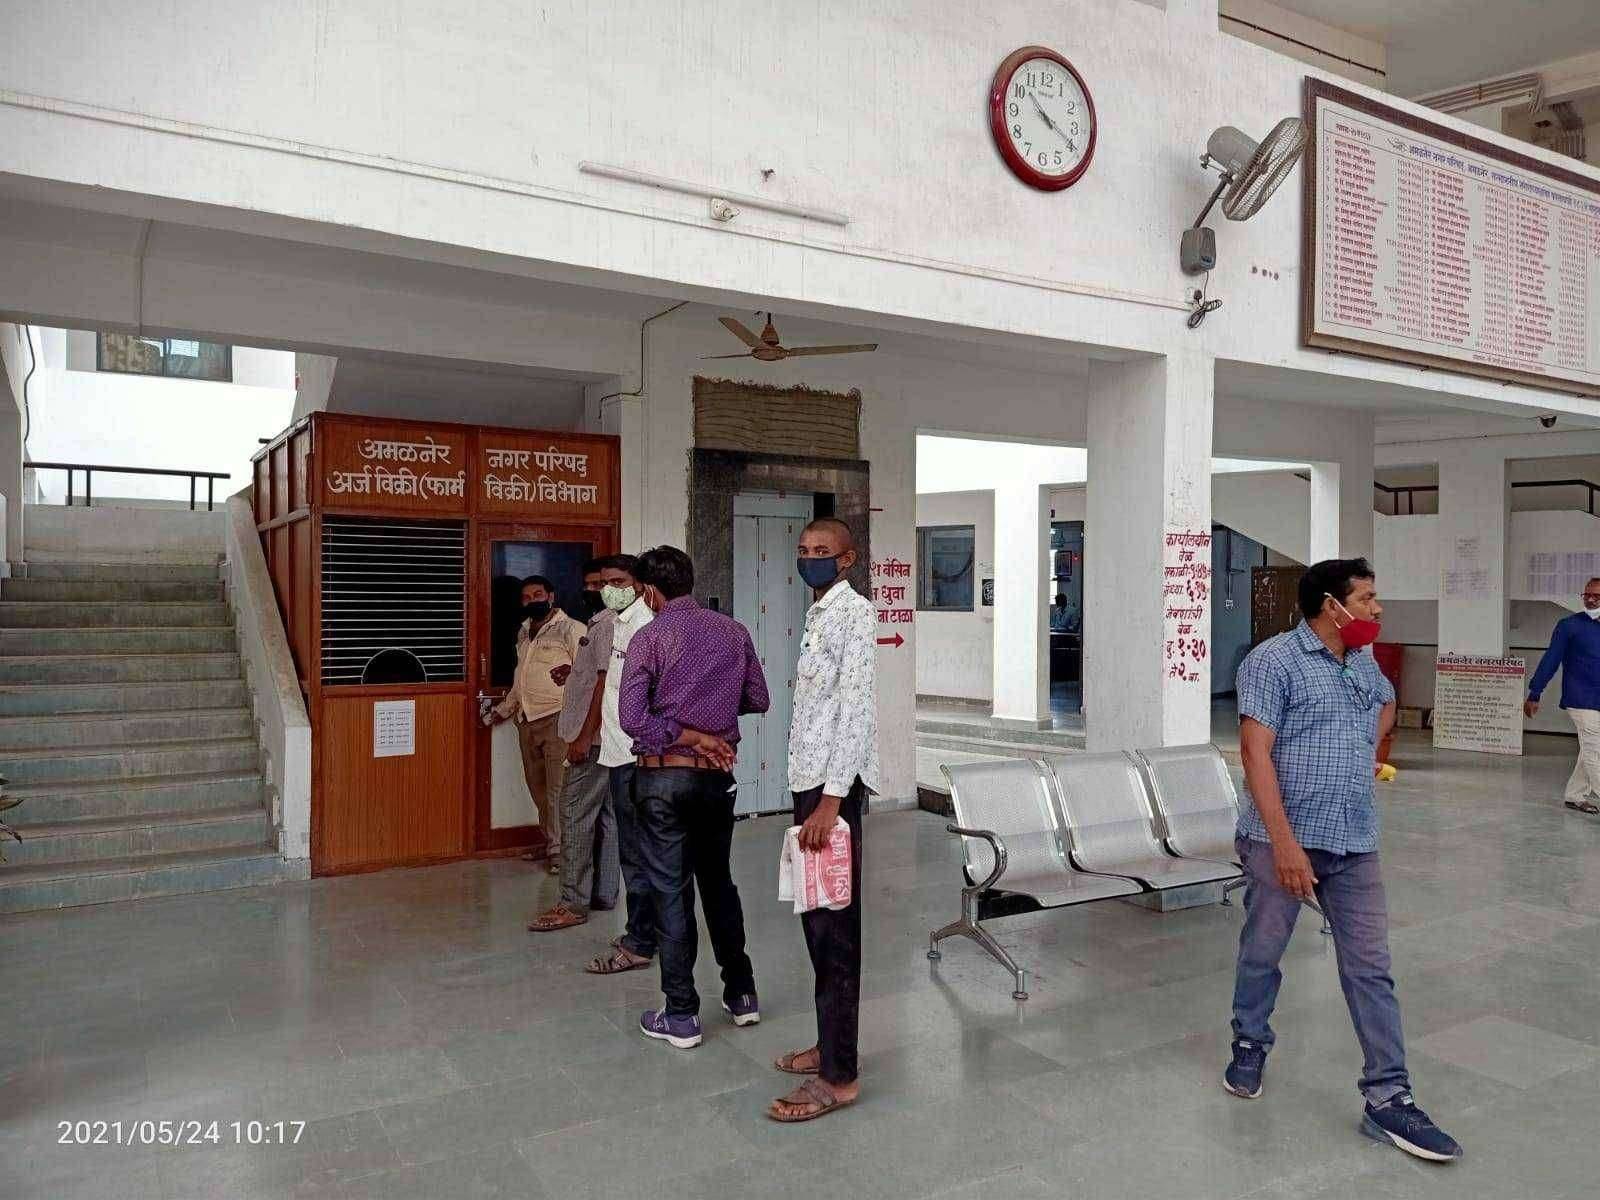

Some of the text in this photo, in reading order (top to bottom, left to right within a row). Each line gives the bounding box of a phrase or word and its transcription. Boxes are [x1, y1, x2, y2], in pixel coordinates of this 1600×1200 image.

[1026, 71, 1037, 88] 11
[1041, 71, 1054, 88] 12
[1014, 83, 1026, 100] 10
[1059, 82, 1064, 98] 1
[1009, 102, 1020, 118] 9
[1066, 100, 1076, 116] 2
[1013, 124, 1022, 139] 8
[1070, 121, 1079, 136] 3
[1023, 141, 1033, 157] 7
[1037, 151, 1048, 167] 6
[1053, 150, 1063, 165] 5
[358, 435, 589, 478] अमळनेर नगर परिषद
[327, 465, 598, 505] अर्ज विक्री (फार्म विक्री) विभाग
[881, 585, 905, 605] धुवा
[889, 608, 914, 624] टाळा
